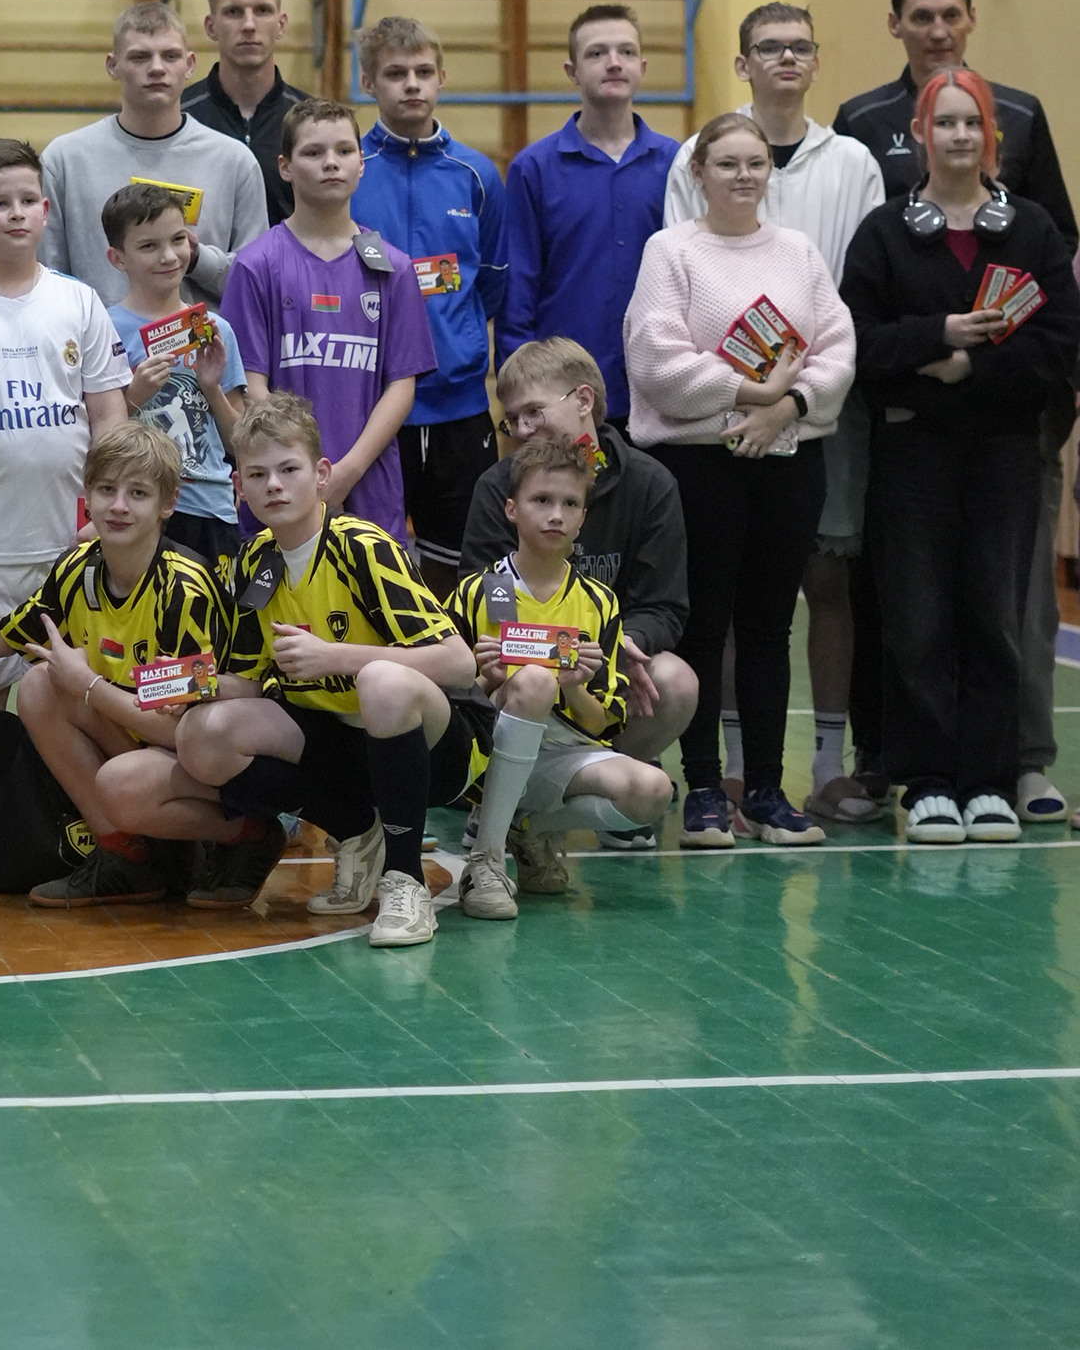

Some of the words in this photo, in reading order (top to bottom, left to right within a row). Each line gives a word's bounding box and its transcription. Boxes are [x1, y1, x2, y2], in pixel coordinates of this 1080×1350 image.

[414, 262, 431, 273] LINE
[147, 319, 183, 341] MAXLINE
[151, 338, 176, 351] ВПЕРЕД
[6, 380, 42, 401] Fly
[255, 578, 271, 588] IROS
[506, 627, 548, 641] MAXLINE
[506, 648, 547, 656] МАКСЛАЙН
[140, 664, 182, 683] MAXLINE
[142, 683, 172, 694] ВПЕРЕД
[143, 686, 185, 699] МАКСЛАЙН
[77, 835, 95, 846] ML
